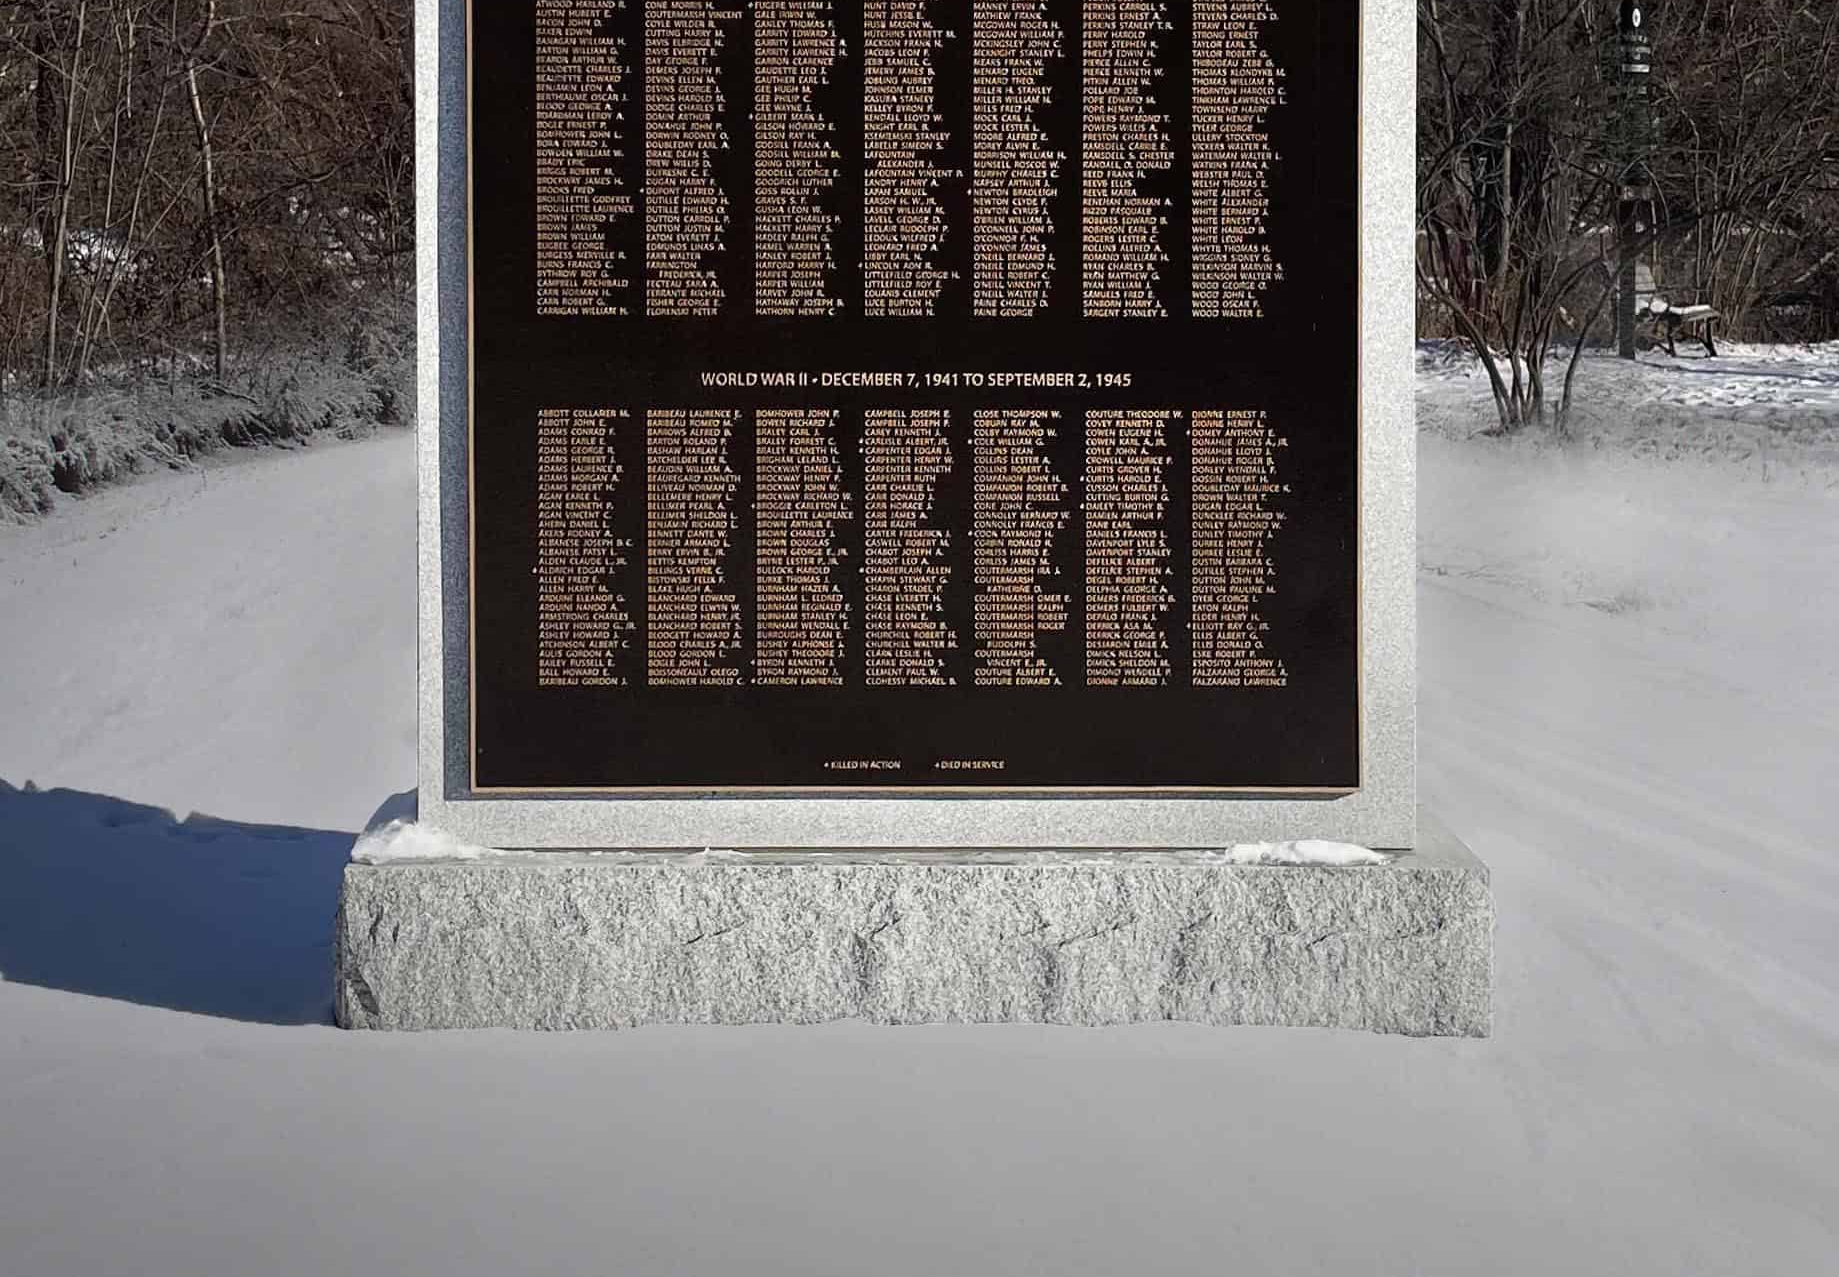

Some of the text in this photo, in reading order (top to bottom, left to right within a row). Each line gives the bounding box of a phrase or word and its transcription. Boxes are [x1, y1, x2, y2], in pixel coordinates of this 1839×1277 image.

[701, 372, 1132, 388] WORLD WAR II DECEMBER 7, 1941 TO SEPTEMBER 2, 1945
